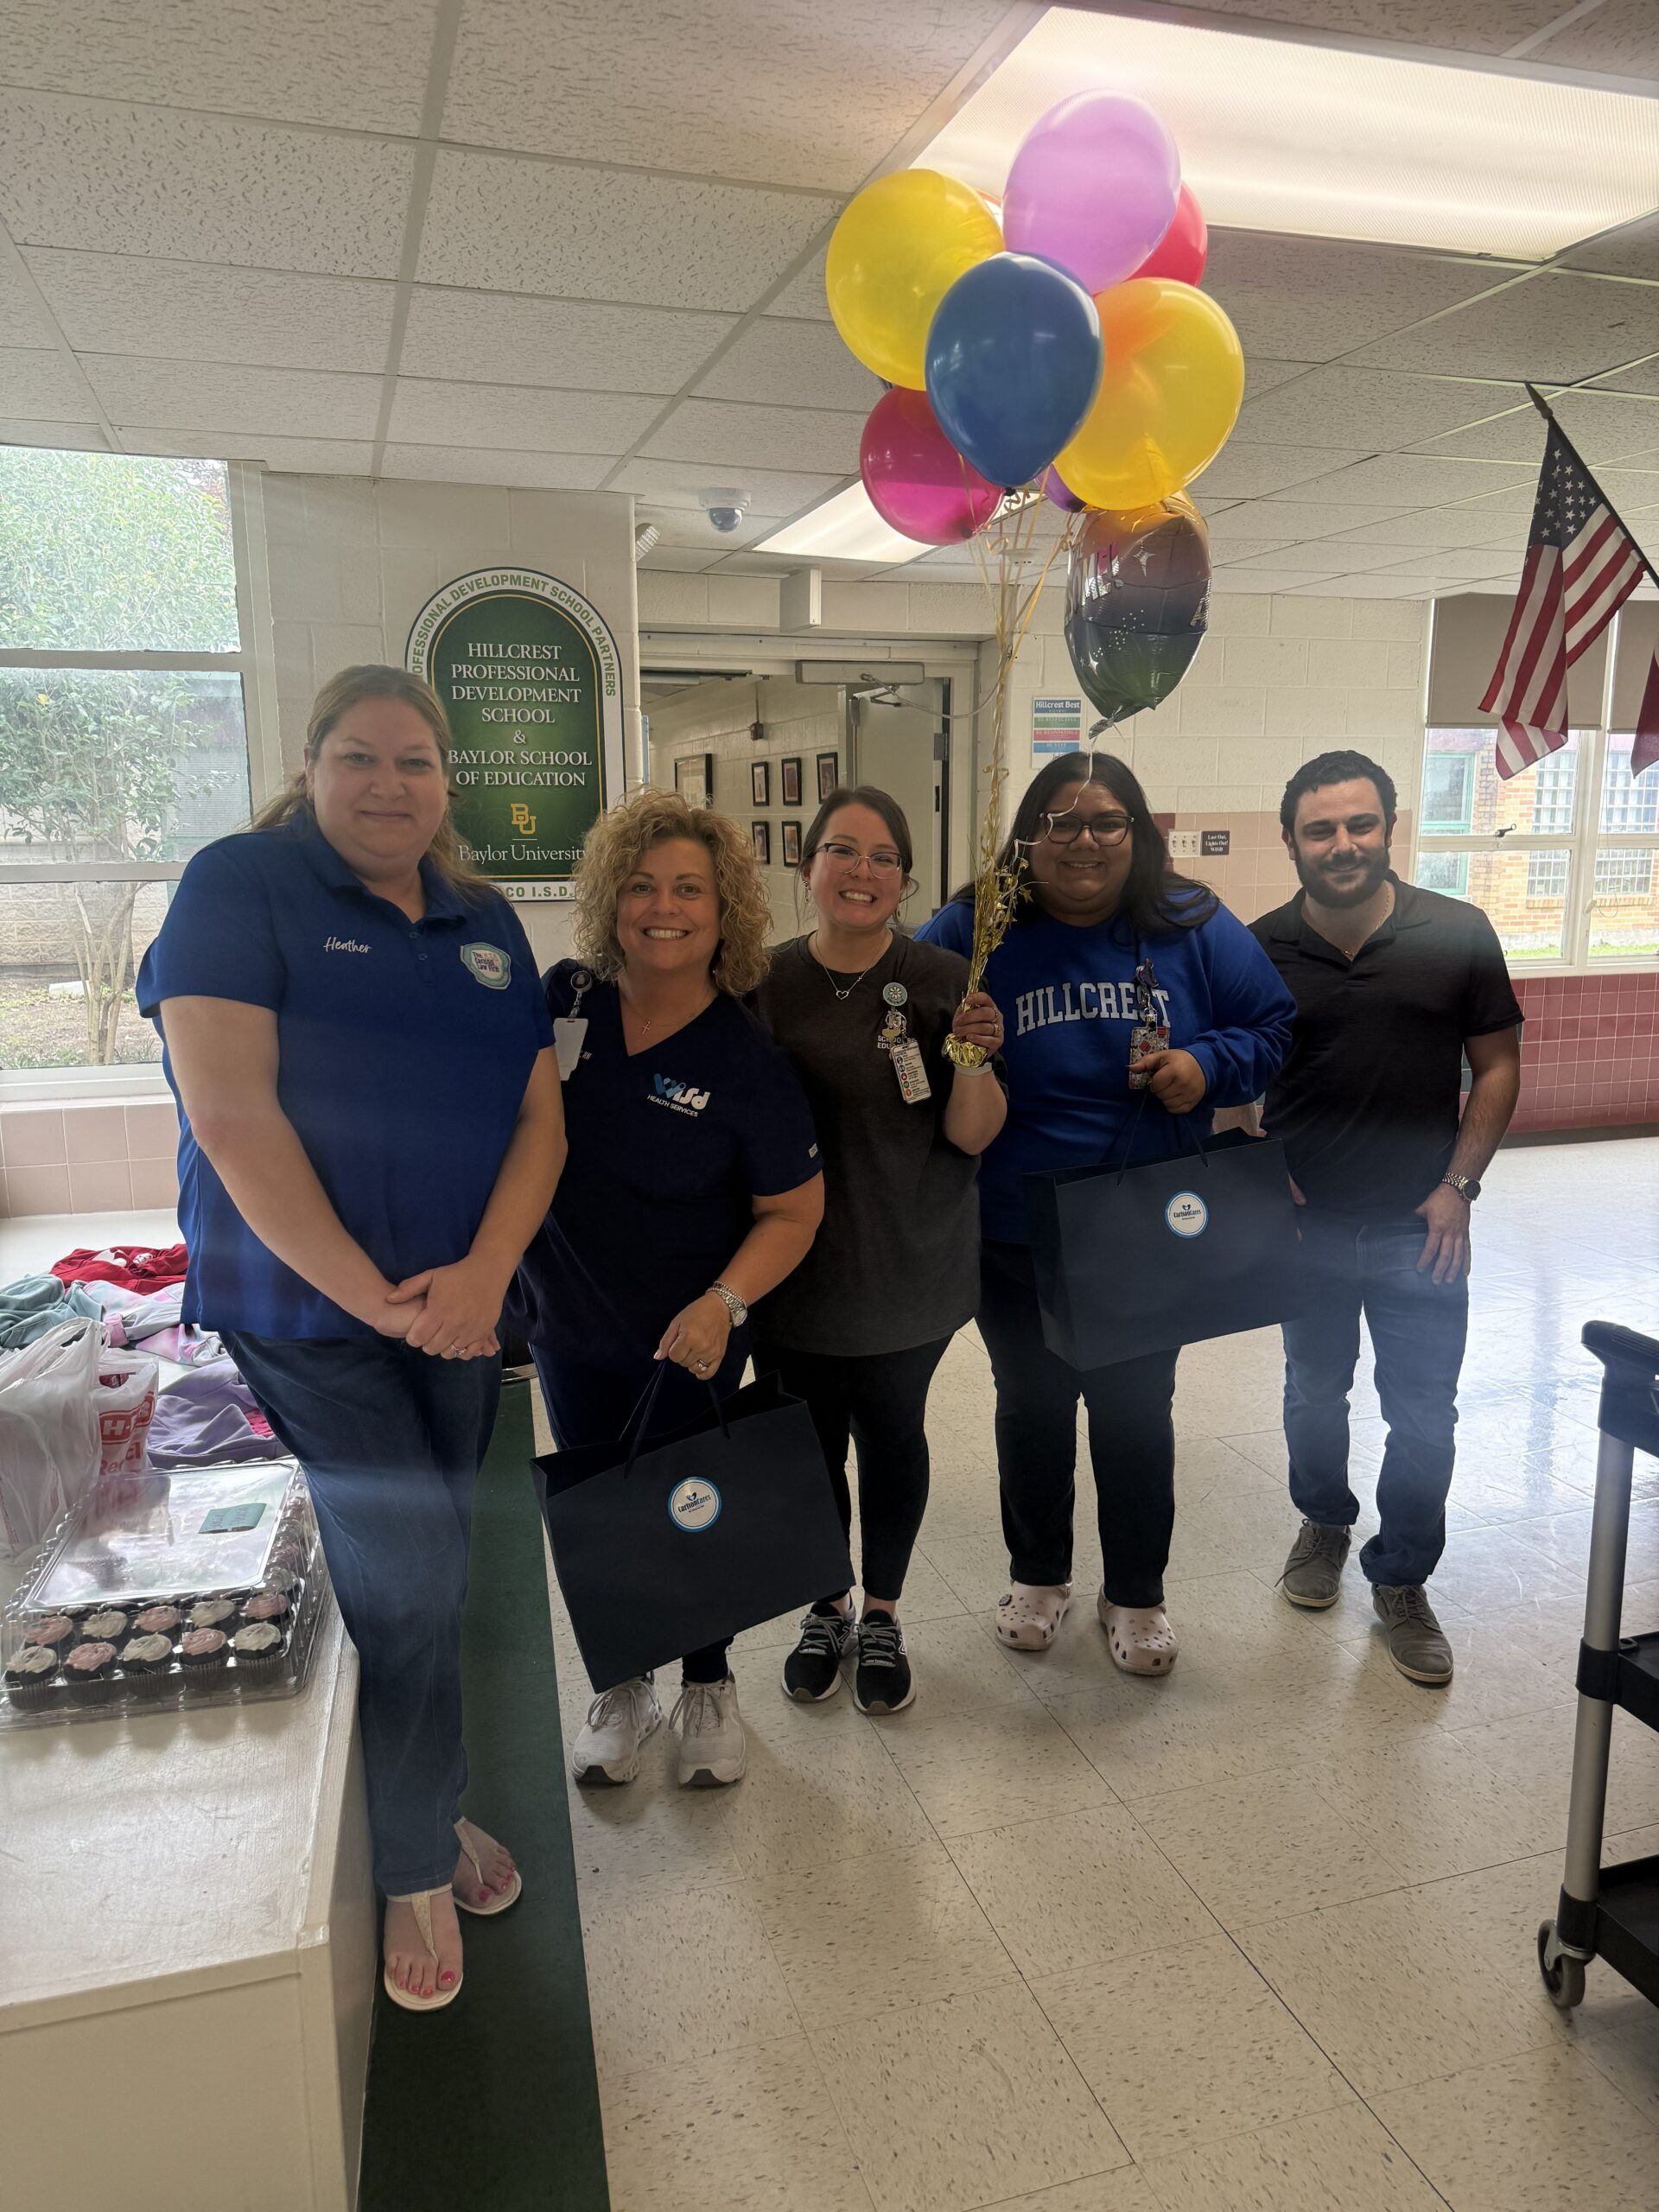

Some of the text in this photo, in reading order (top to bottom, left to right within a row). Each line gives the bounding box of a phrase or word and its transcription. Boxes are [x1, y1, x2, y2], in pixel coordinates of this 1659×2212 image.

[411, 574, 617, 697] OFESSIONAL DEVELOPMENT SCHOOL PARTNERS
[467, 643, 562, 660] HILLCREST
[451, 664, 580, 682] PROFESSIONAL
[451, 685, 582, 703] DEVELOPMENT
[481, 708, 556, 723] SCHOOL
[512, 730, 526, 744] &
[448, 750, 593, 766] BAYLOR SCHOOL
[455, 771, 586, 786] OF EDUCATION
[511, 803, 537, 835] BU
[459, 845, 508, 864] Baylor
[506, 886, 573, 897] CO I.S.D.
[323, 937, 372, 954] Heather
[646, 1094, 699, 1117] HEALTH SERVICES
